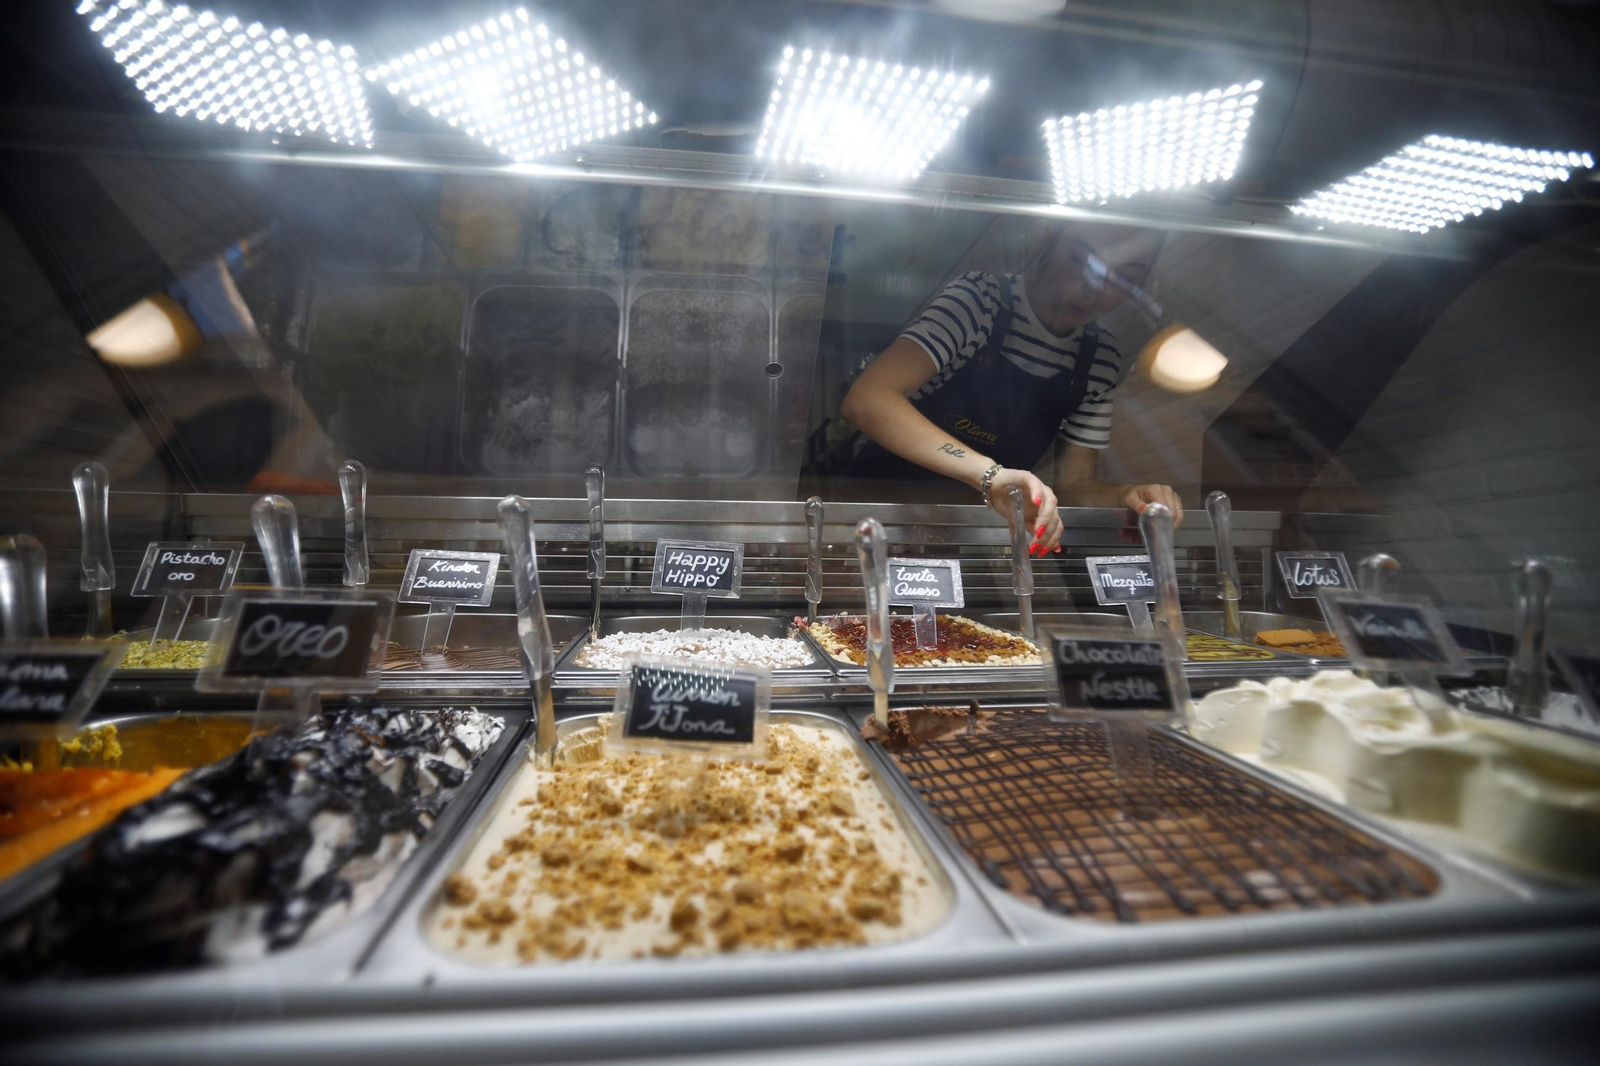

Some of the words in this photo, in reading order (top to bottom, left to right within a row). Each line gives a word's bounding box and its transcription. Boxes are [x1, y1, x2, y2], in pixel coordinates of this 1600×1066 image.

[161, 551, 225, 566] Pistacho
[667, 551, 730, 575] Happy
[168, 572, 195, 581] oro
[665, 569, 720, 587] Hippo
[1100, 571, 1155, 595] Mezquita
[1294, 561, 1341, 587] Lotus
[894, 582, 941, 597] Queso
[239, 613, 350, 660] Oreo
